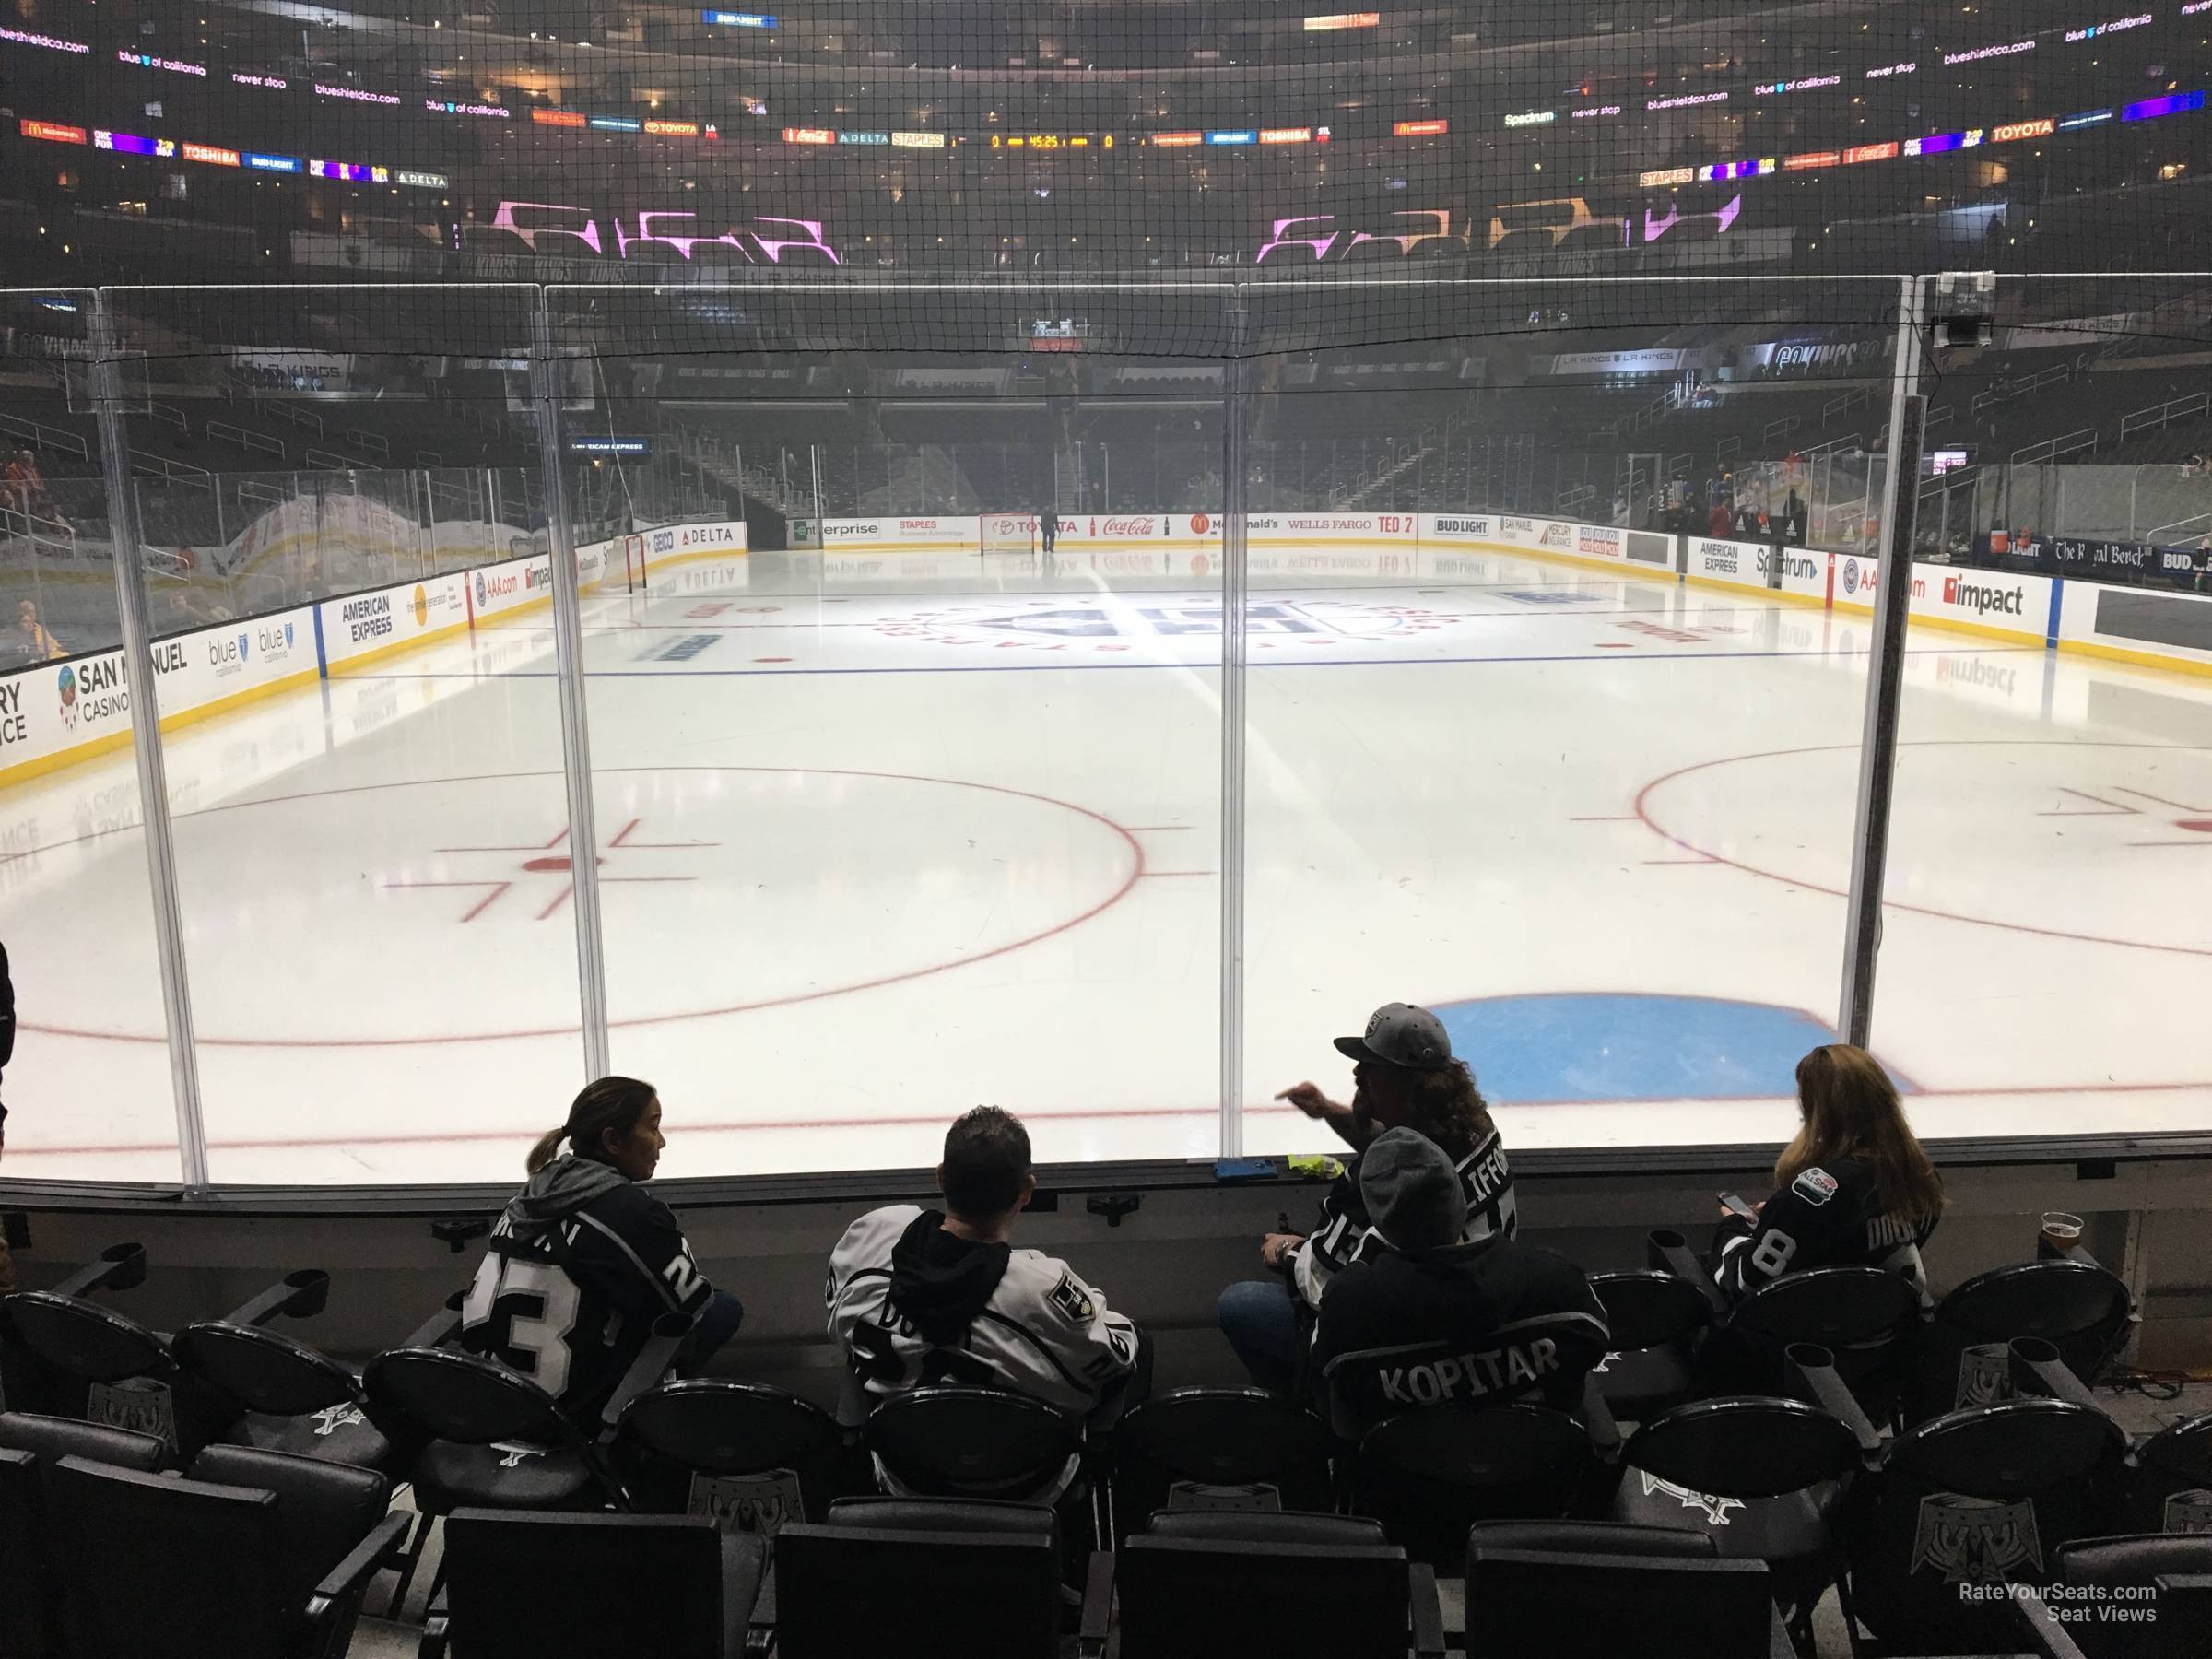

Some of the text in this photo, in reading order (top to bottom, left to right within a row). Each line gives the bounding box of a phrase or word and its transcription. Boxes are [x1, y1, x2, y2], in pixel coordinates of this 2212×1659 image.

[2065, 14, 2152, 42] blue of california
[1944, 41, 2035, 65] blueshieldca.com
[119, 51, 206, 76] blue of california
[1867, 62, 1916, 79] never stop
[232, 73, 287, 89] never stop
[1755, 74, 1841, 95] blue of california
[315, 84, 400, 105] blueshieldca.com
[1648, 92, 1728, 110] blueshieldca.com
[426, 100, 509, 118] blue of california
[1572, 104, 1620, 118] never stop
[1505, 111, 1554, 126] Spectrum
[660, 124, 697, 134] TOYOTA
[1261, 130, 1310, 142] TOSHIBA
[1994, 120, 2053, 140] TOYOTA
[852, 134, 888, 144] DELTA
[892, 134, 942, 146] STAPLES
[1029, 135, 1058, 147] 45:25
[1105, 135, 1112, 147] 0
[184, 147, 237, 164] TOSHIBA
[409, 173, 446, 186] DELTA
[1642, 170, 1691, 184] STAPLES
[1581, 355, 1611, 364] KINGS
[1641, 352, 1674, 361] KINGS
[899, 520, 936, 529] STAPLES
[1017, 521, 1077, 533] TOYTA
[1103, 517, 1156, 535] Coca-Cola
[1288, 520, 1371, 529] WELLS FARGO
[1378, 516, 1413, 533] TED 7
[1437, 519, 1487, 534] BUD LIGHT
[1505, 517, 1516, 529] SAN
[1549, 524, 1571, 535] MERCURY
[653, 531, 674, 553] GEICO
[692, 527, 733, 544] DELTA
[1700, 542, 1738, 559] AMERICAN
[2055, 541, 2144, 569] The Ryal Bench
[1705, 557, 1738, 573] EXPRESS
[1756, 547, 1813, 579] Spctrum
[2163, 553, 2192, 570] BUD
[487, 575, 518, 598] AAA.com
[1956, 573, 2023, 616] impact
[343, 595, 390, 623] AMERICAN
[351, 616, 392, 642] EXPRESS
[259, 626, 283, 652] blue
[209, 638, 237, 665] blue
[79, 658, 118, 695] SAN
[83, 692, 129, 722] CASINO
[1752, 1228, 1796, 1277] 8
[1380, 1336, 1560, 1406] KOPITAR
